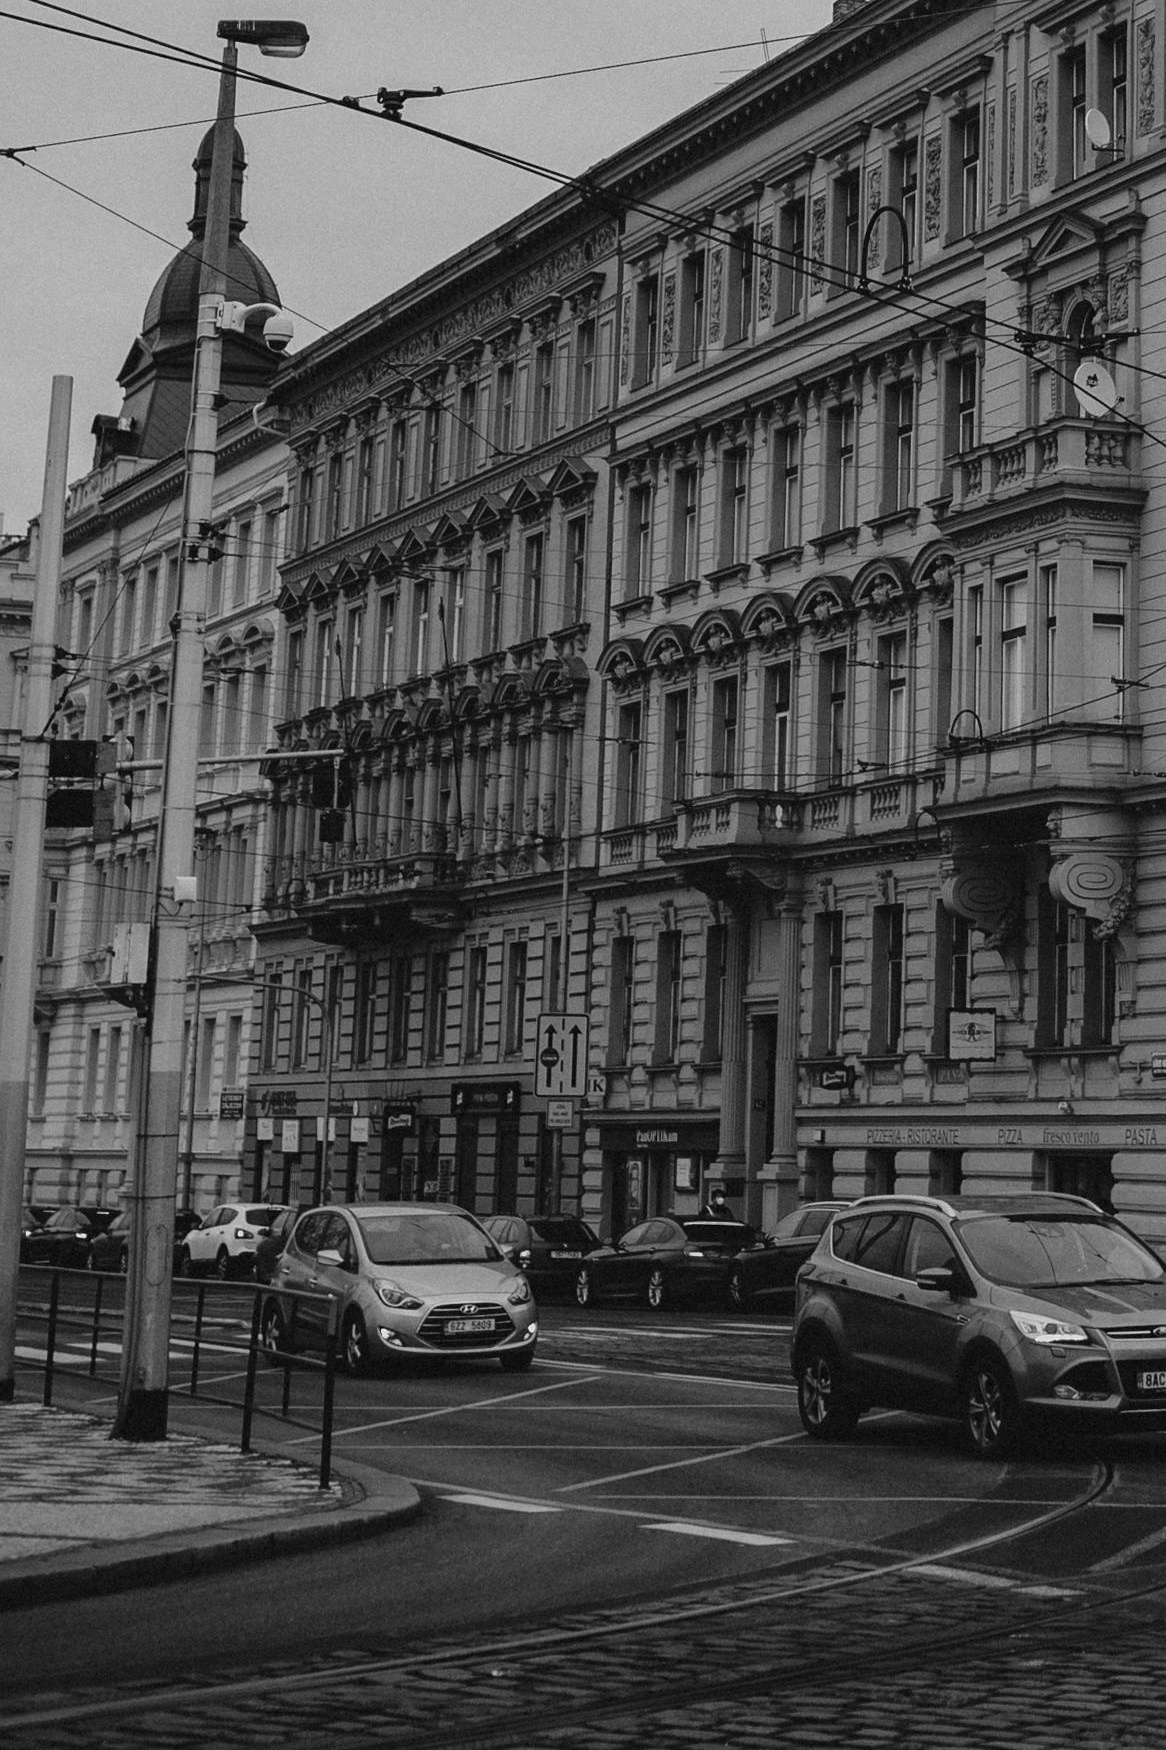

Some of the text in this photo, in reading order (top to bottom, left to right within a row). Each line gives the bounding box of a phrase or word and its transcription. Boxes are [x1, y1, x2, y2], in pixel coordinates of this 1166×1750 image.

[867, 1128, 902, 1144] PIZZERIA
[908, 1128, 960, 1144] RISTORANTE
[998, 1128, 1023, 1144] PIZZA
[1043, 1128, 1100, 1143] fresco vento
[1125, 1128, 1158, 1144] PASTA
[1146, 1373, 1166, 1387] 8AC
